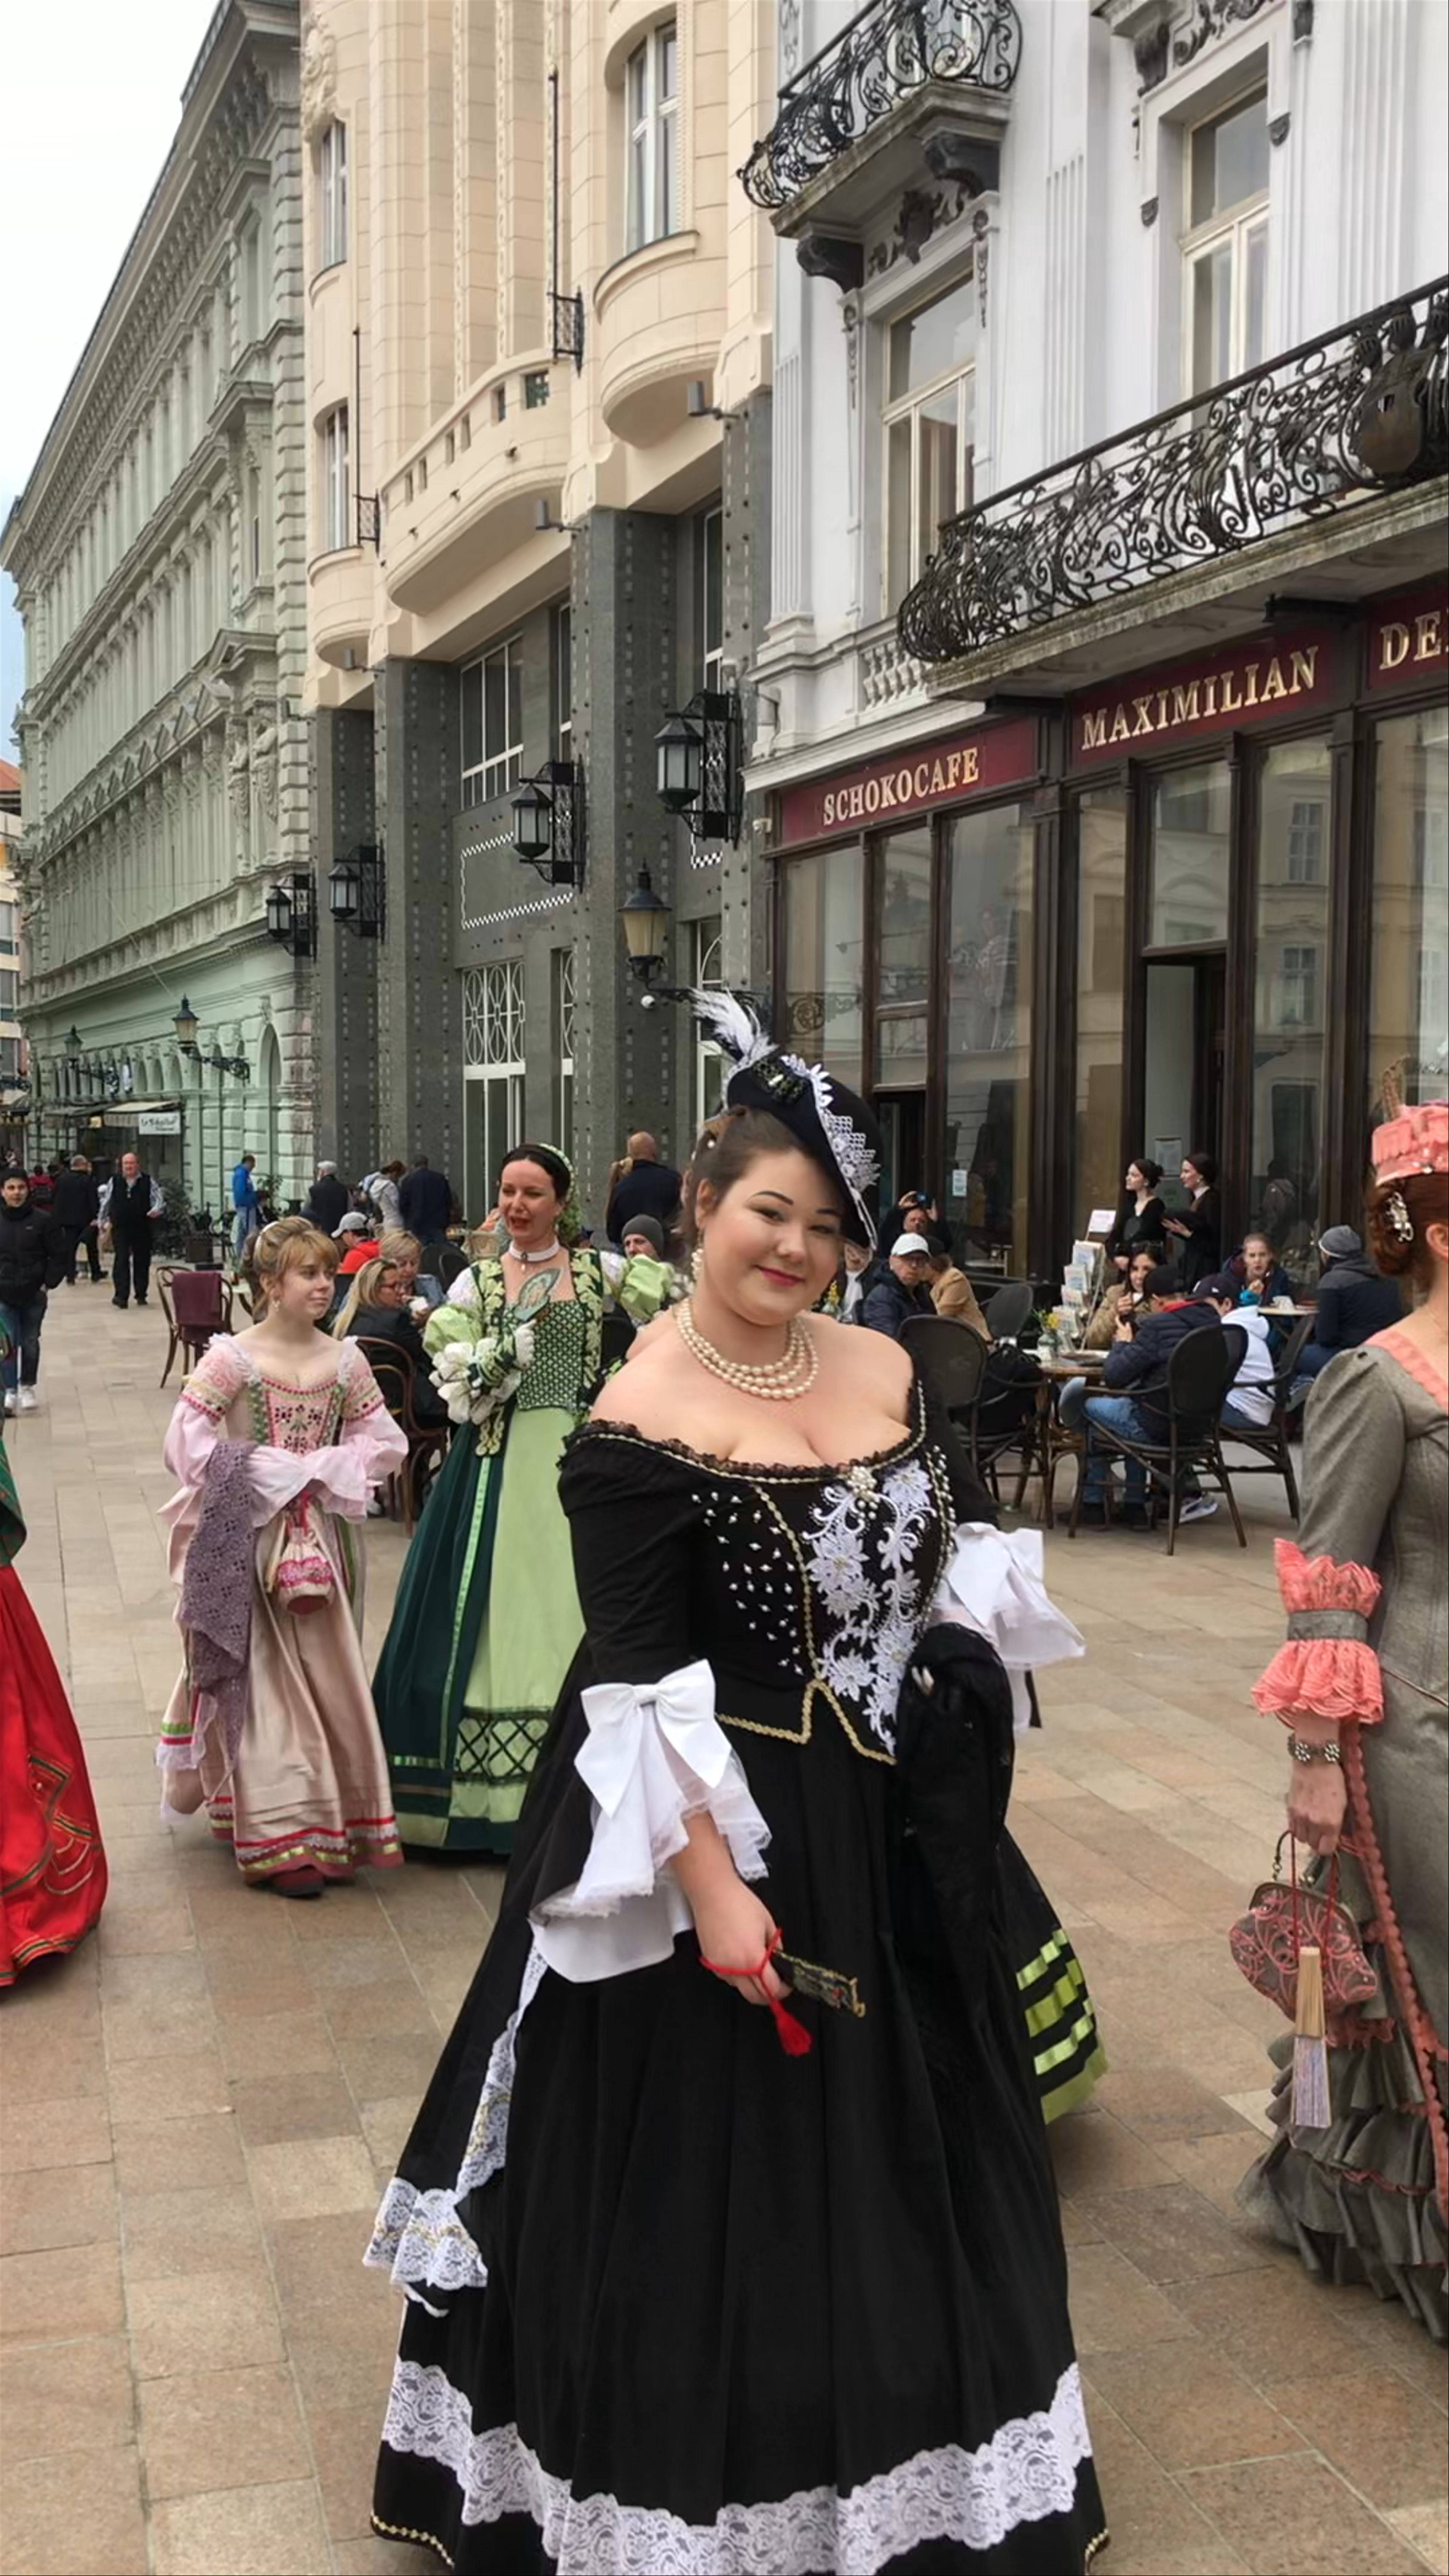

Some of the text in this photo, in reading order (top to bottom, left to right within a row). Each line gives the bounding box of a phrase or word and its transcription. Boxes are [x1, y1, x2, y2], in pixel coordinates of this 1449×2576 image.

[823, 608, 1449, 826] SCHOKOCAFE MAXIMILIAN DE
